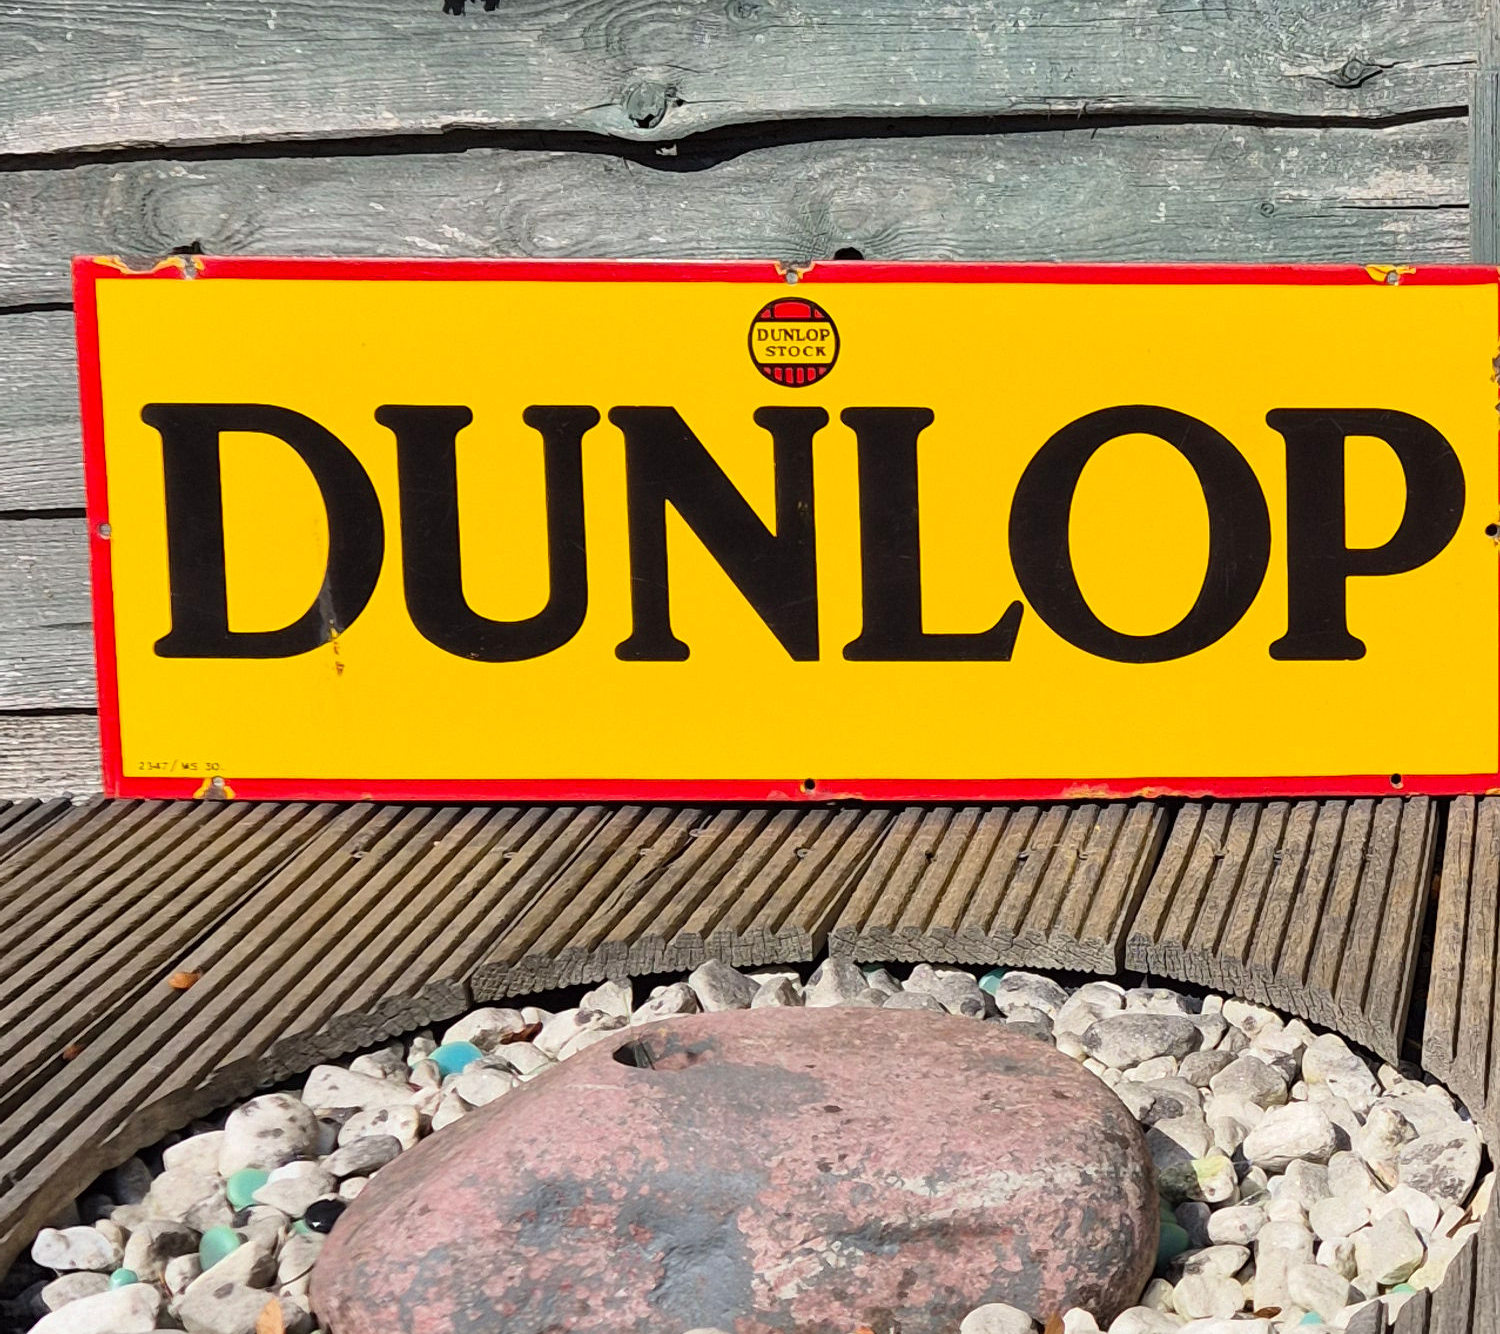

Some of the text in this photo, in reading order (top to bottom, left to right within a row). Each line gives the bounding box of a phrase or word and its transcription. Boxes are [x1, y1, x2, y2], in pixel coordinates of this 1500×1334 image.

[757, 328, 830, 342] DUNLOP
[765, 346, 826, 357] STOCK
[142, 404, 1466, 663] DUNLOP
